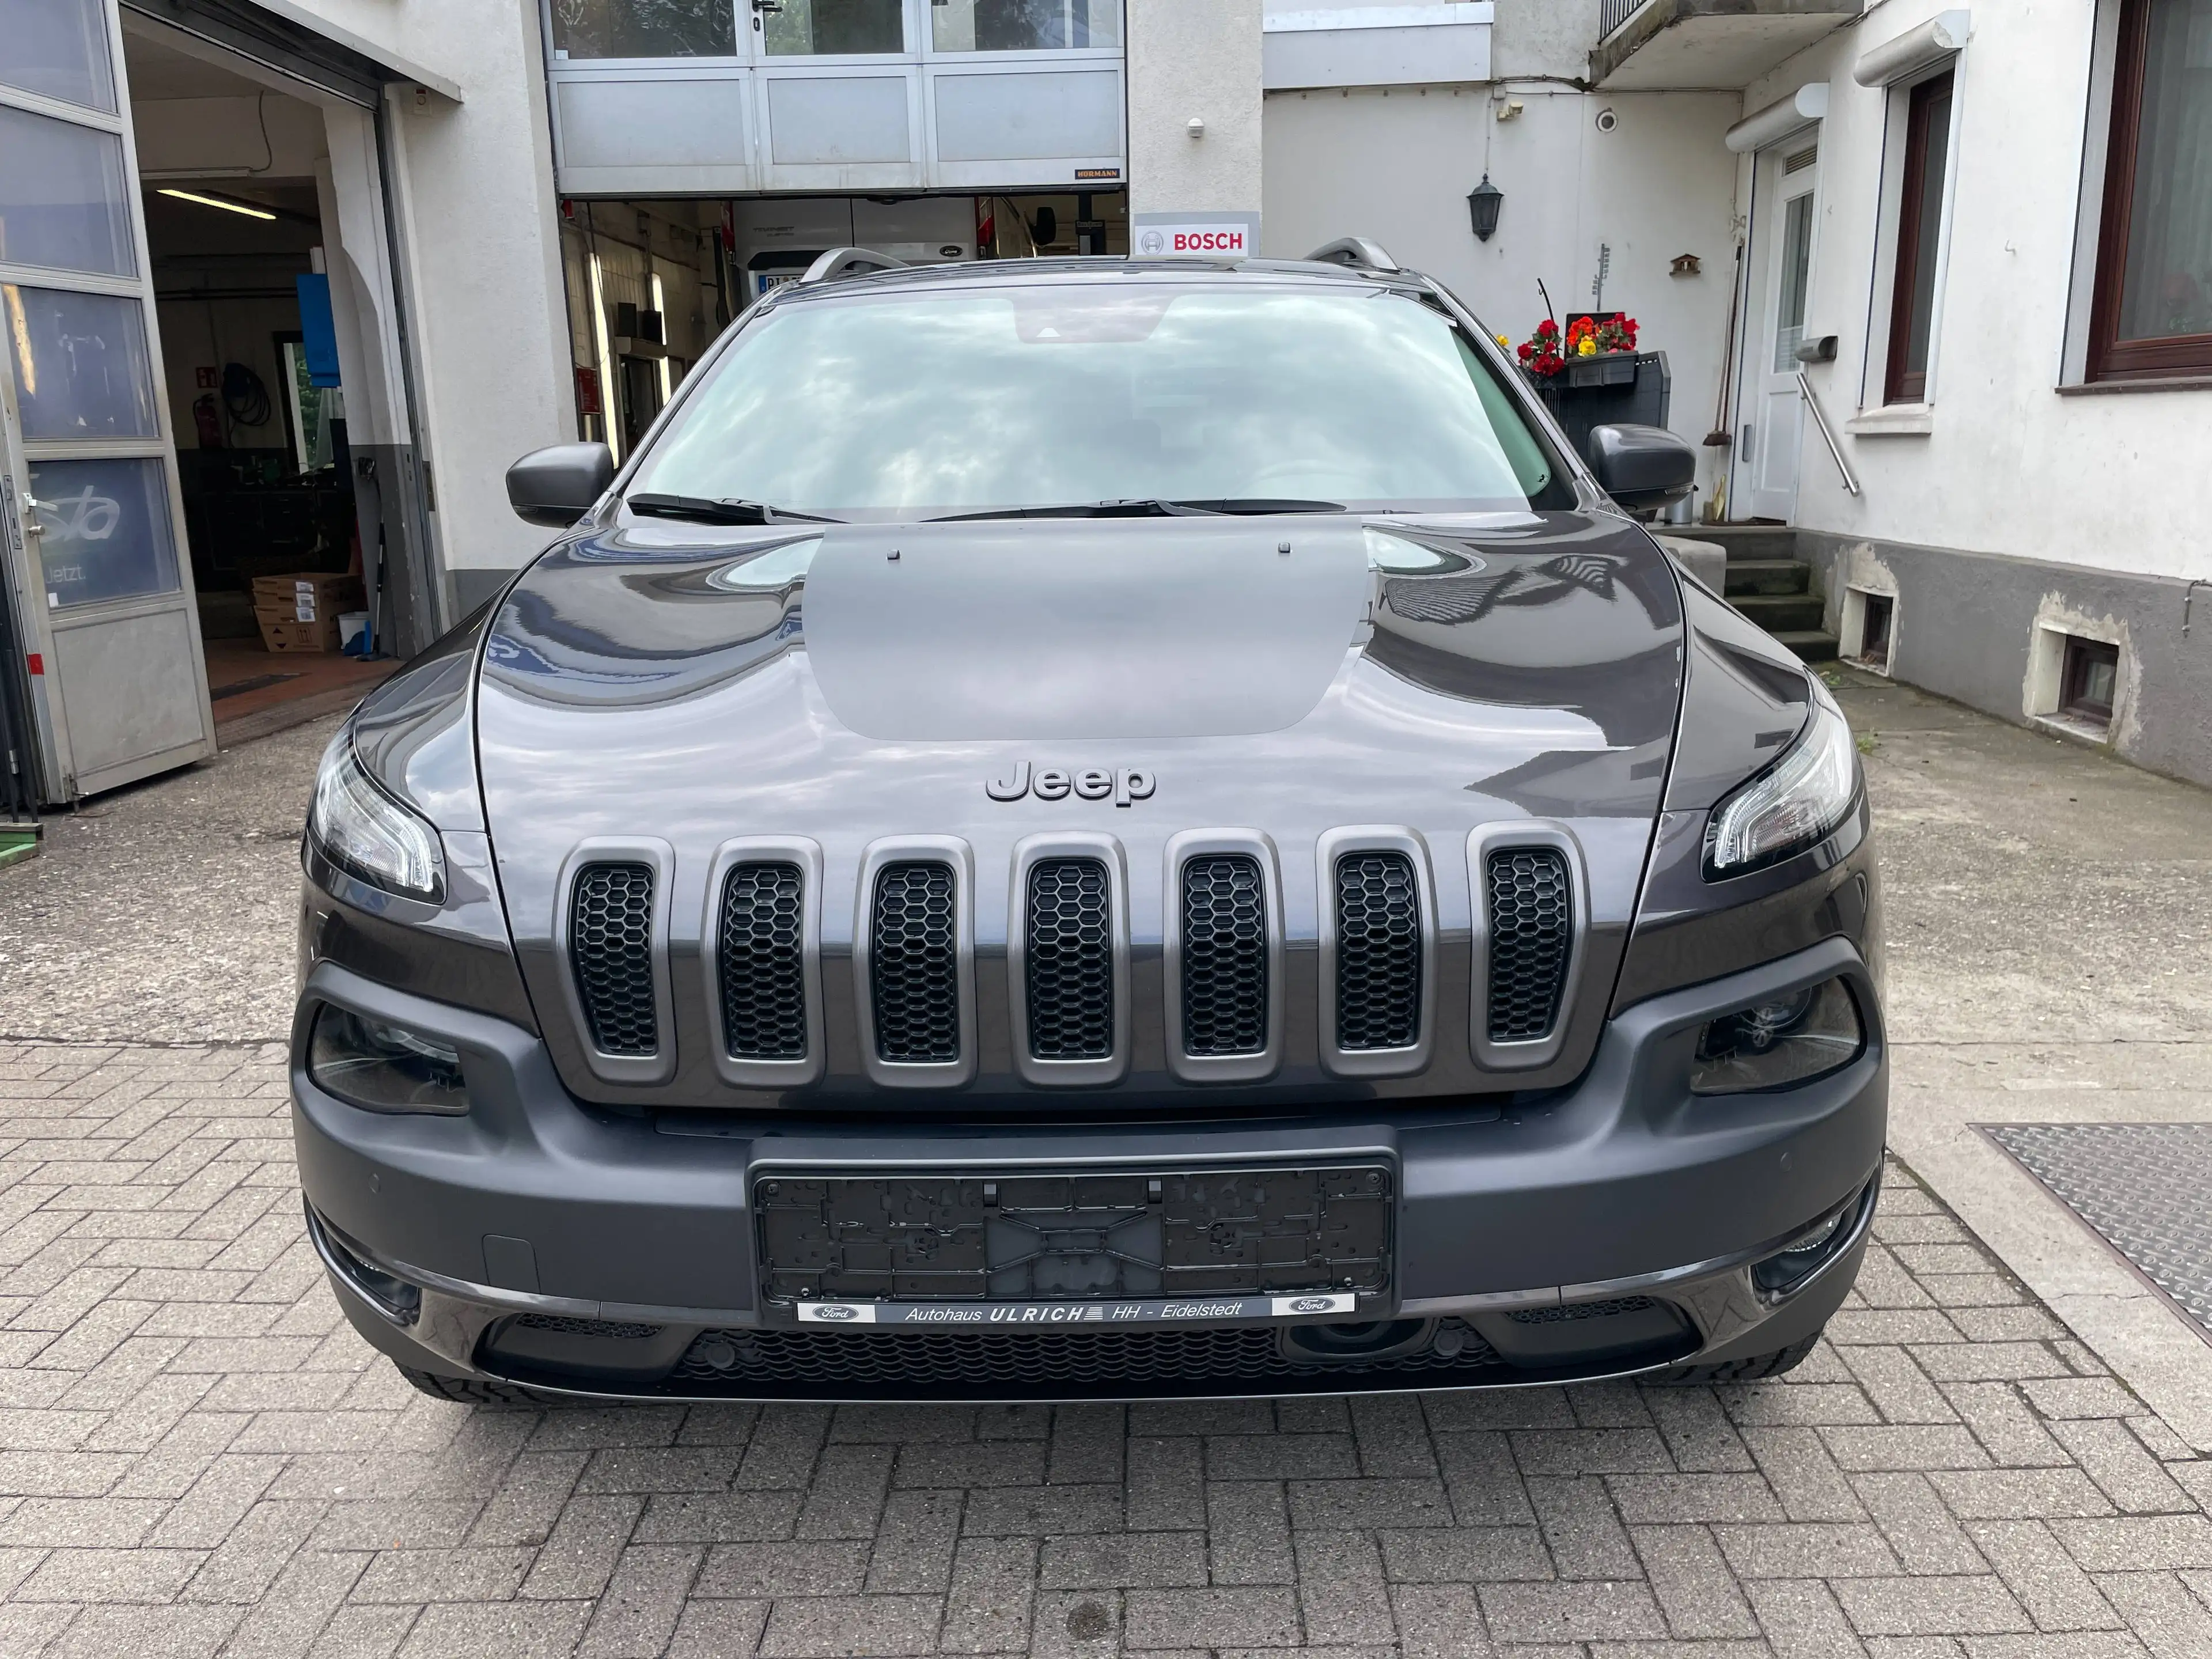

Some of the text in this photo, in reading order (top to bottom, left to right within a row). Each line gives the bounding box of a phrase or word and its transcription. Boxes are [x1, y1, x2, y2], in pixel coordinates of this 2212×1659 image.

[1174, 233, 1242, 251] BOSCH
[986, 760, 1157, 808] Jeep
[821, 1307, 849, 1319] Ford
[904, 1307, 983, 1321] Autohaus
[988, 1306, 1085, 1322] ULRICH
[1111, 1306, 1141, 1319] HH
[1160, 1301, 1243, 1318] Eidelstedt
[1297, 1298, 1325, 1311] Ford
